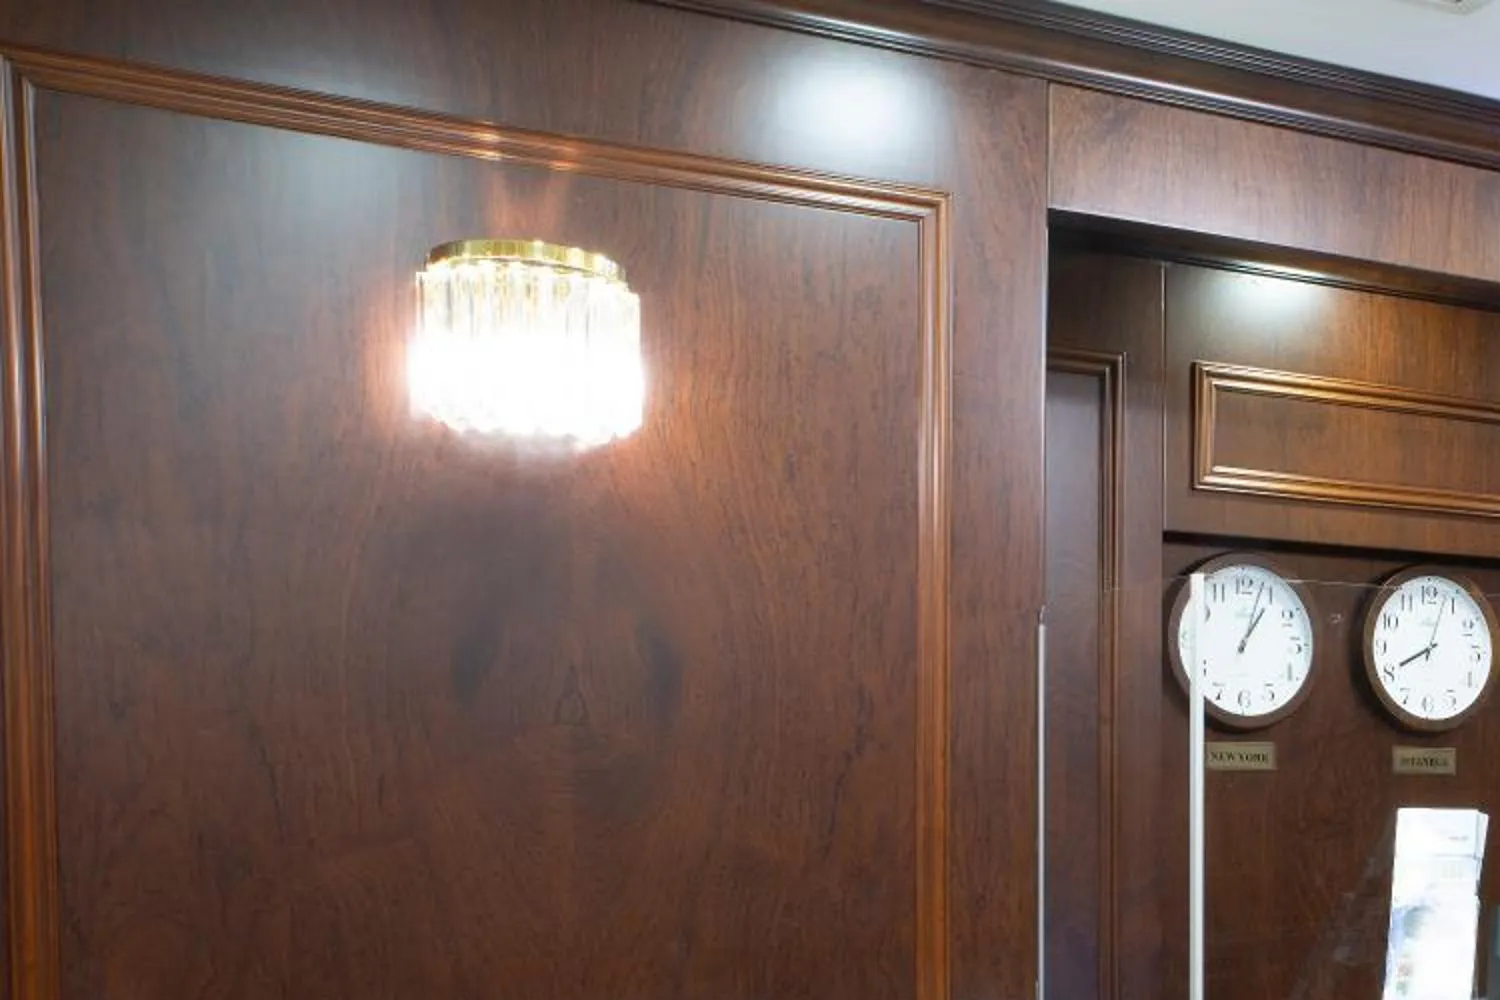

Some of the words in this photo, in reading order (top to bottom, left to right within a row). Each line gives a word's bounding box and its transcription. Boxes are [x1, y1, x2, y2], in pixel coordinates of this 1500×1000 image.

[1213, 583, 1226, 603] 11
[1235, 578, 1253, 595] 12
[1421, 585, 1438, 605] 12
[1401, 593, 1413, 612] 11
[1281, 609, 1294, 627] 2
[1383, 614, 1398, 631] 10
[1462, 619, 1474, 637] 2
[1383, 663, 1395, 682] 8
[1210, 751, 1235, 763] NEW
